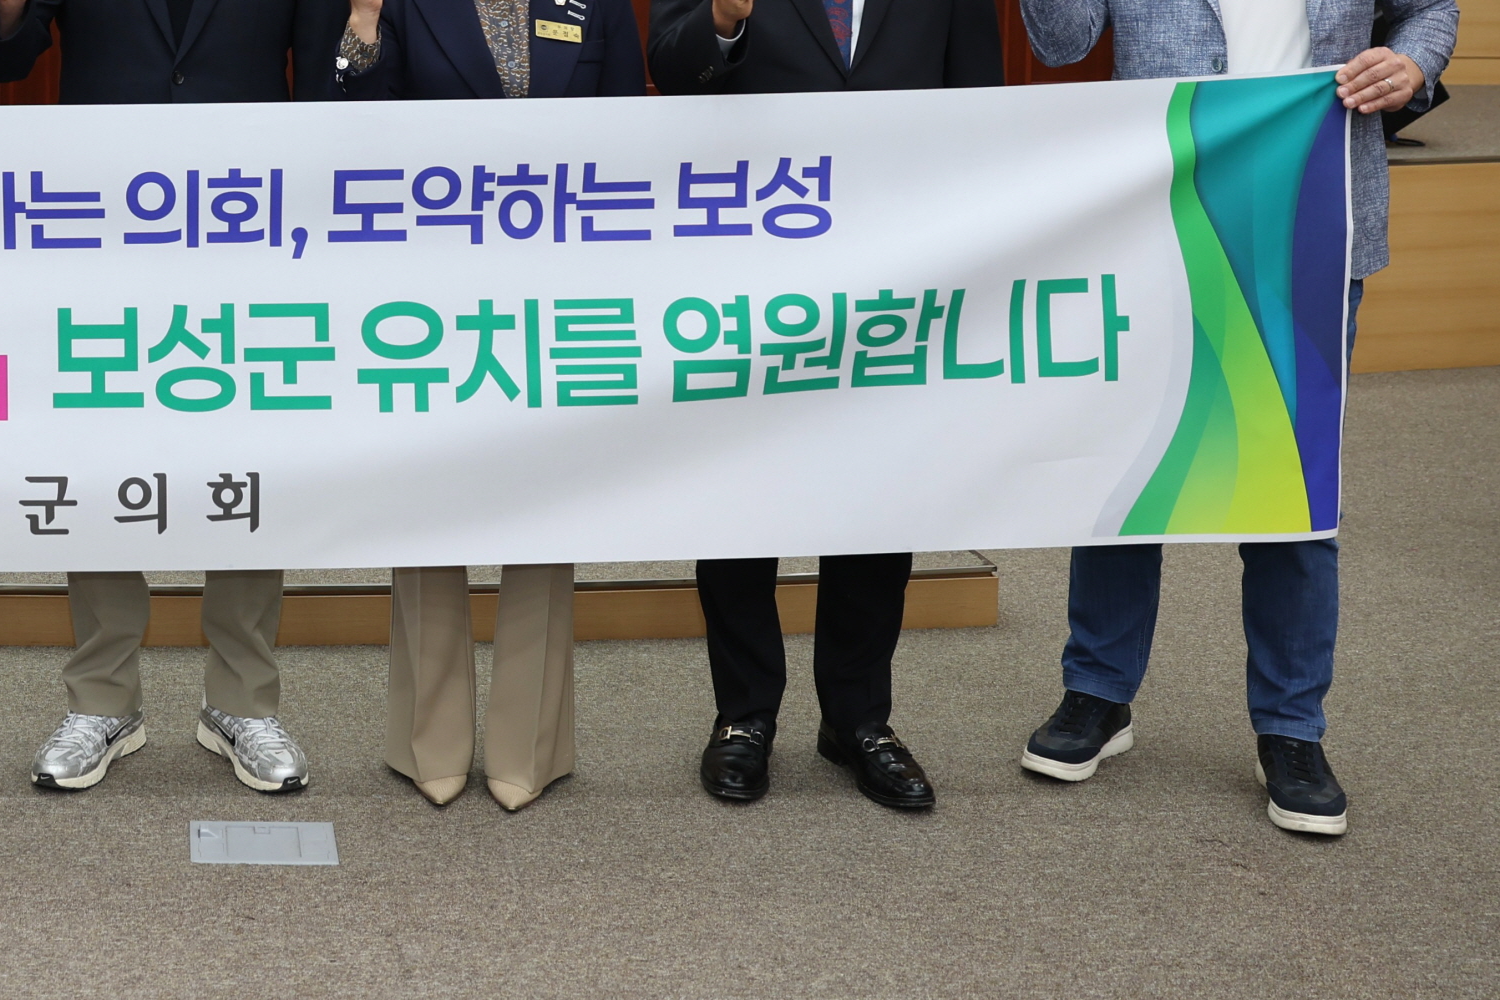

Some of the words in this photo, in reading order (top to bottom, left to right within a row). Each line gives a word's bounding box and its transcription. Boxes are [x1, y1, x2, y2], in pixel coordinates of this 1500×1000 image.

[124, 169, 307, 258] 의회,
[328, 163, 654, 244] 도약하는
[674, 156, 831, 238] 보성
[53, 303, 335, 412] 보성군
[358, 298, 641, 412] 유치를
[664, 274, 1129, 402] 염원합니다
